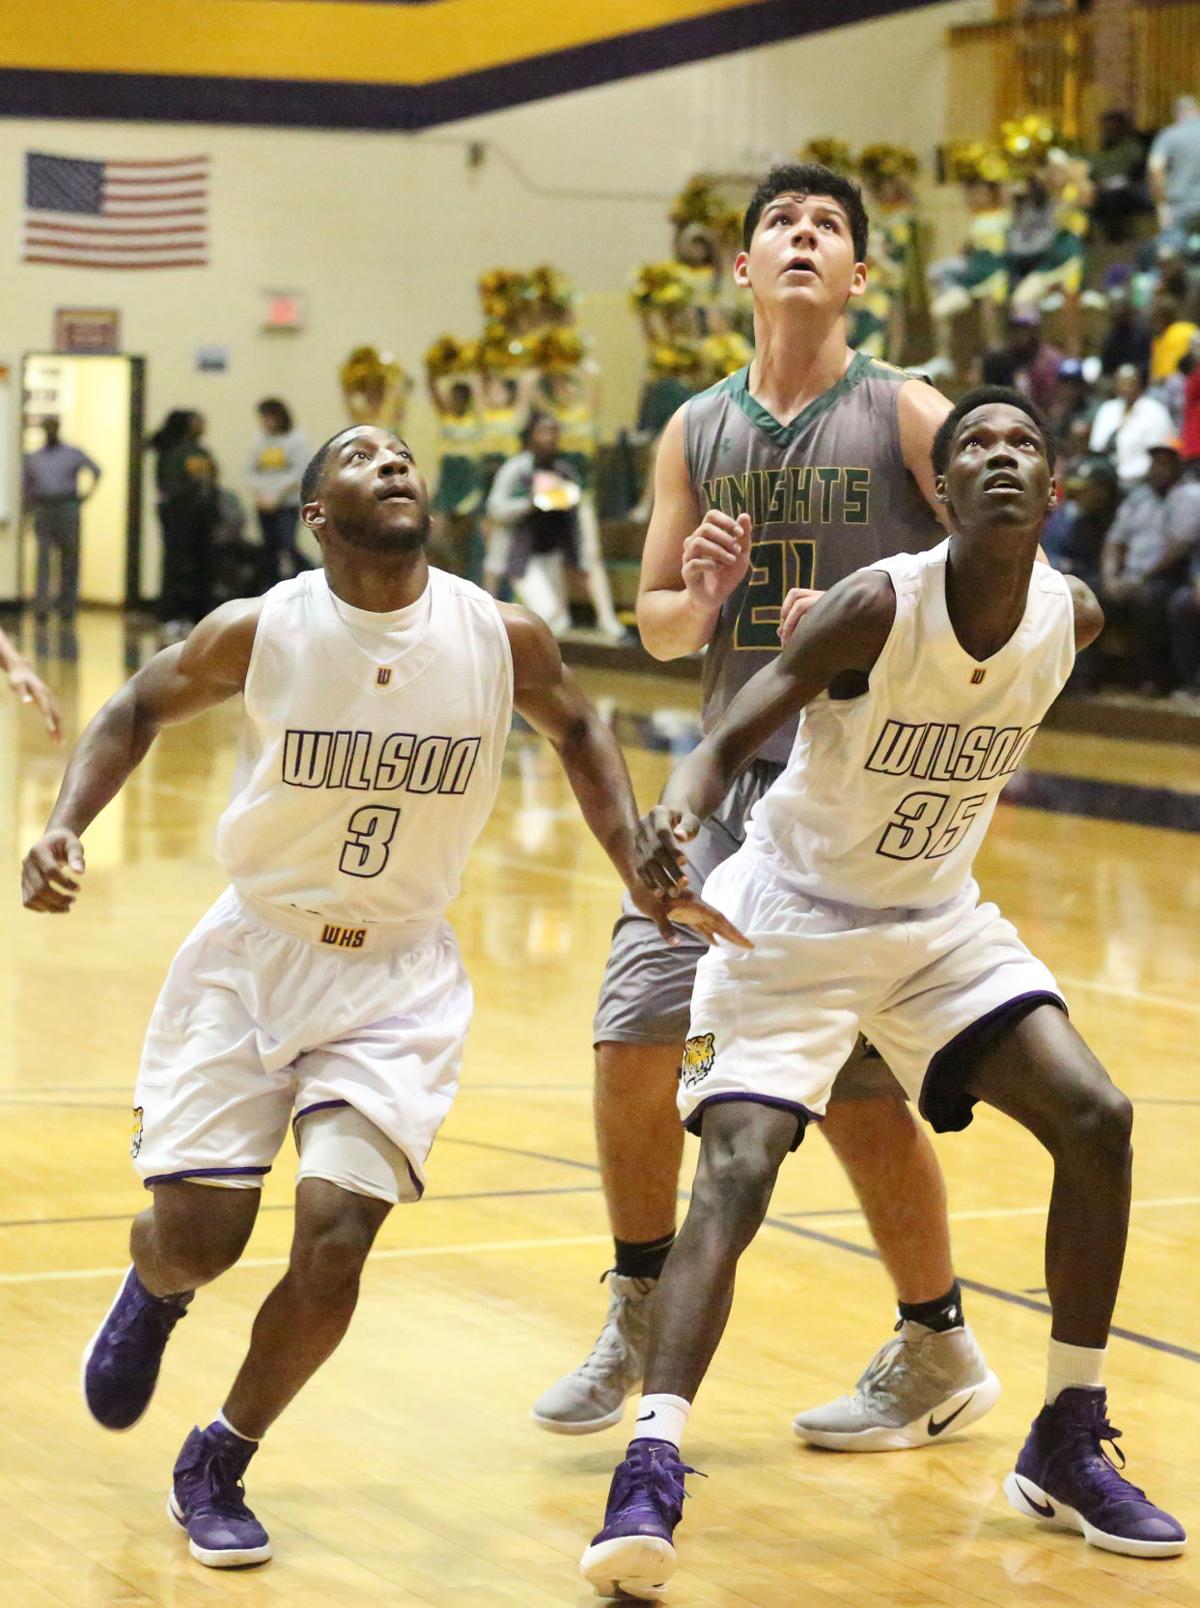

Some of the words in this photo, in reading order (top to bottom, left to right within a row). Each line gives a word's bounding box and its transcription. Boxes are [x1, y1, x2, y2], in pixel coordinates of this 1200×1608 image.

[376, 668, 392, 685] W
[970, 668, 986, 685] W
[282, 729, 481, 795] WILSON
[338, 804, 401, 878] 3
[876, 791, 988, 861] 35
[321, 924, 367, 949] WHS
